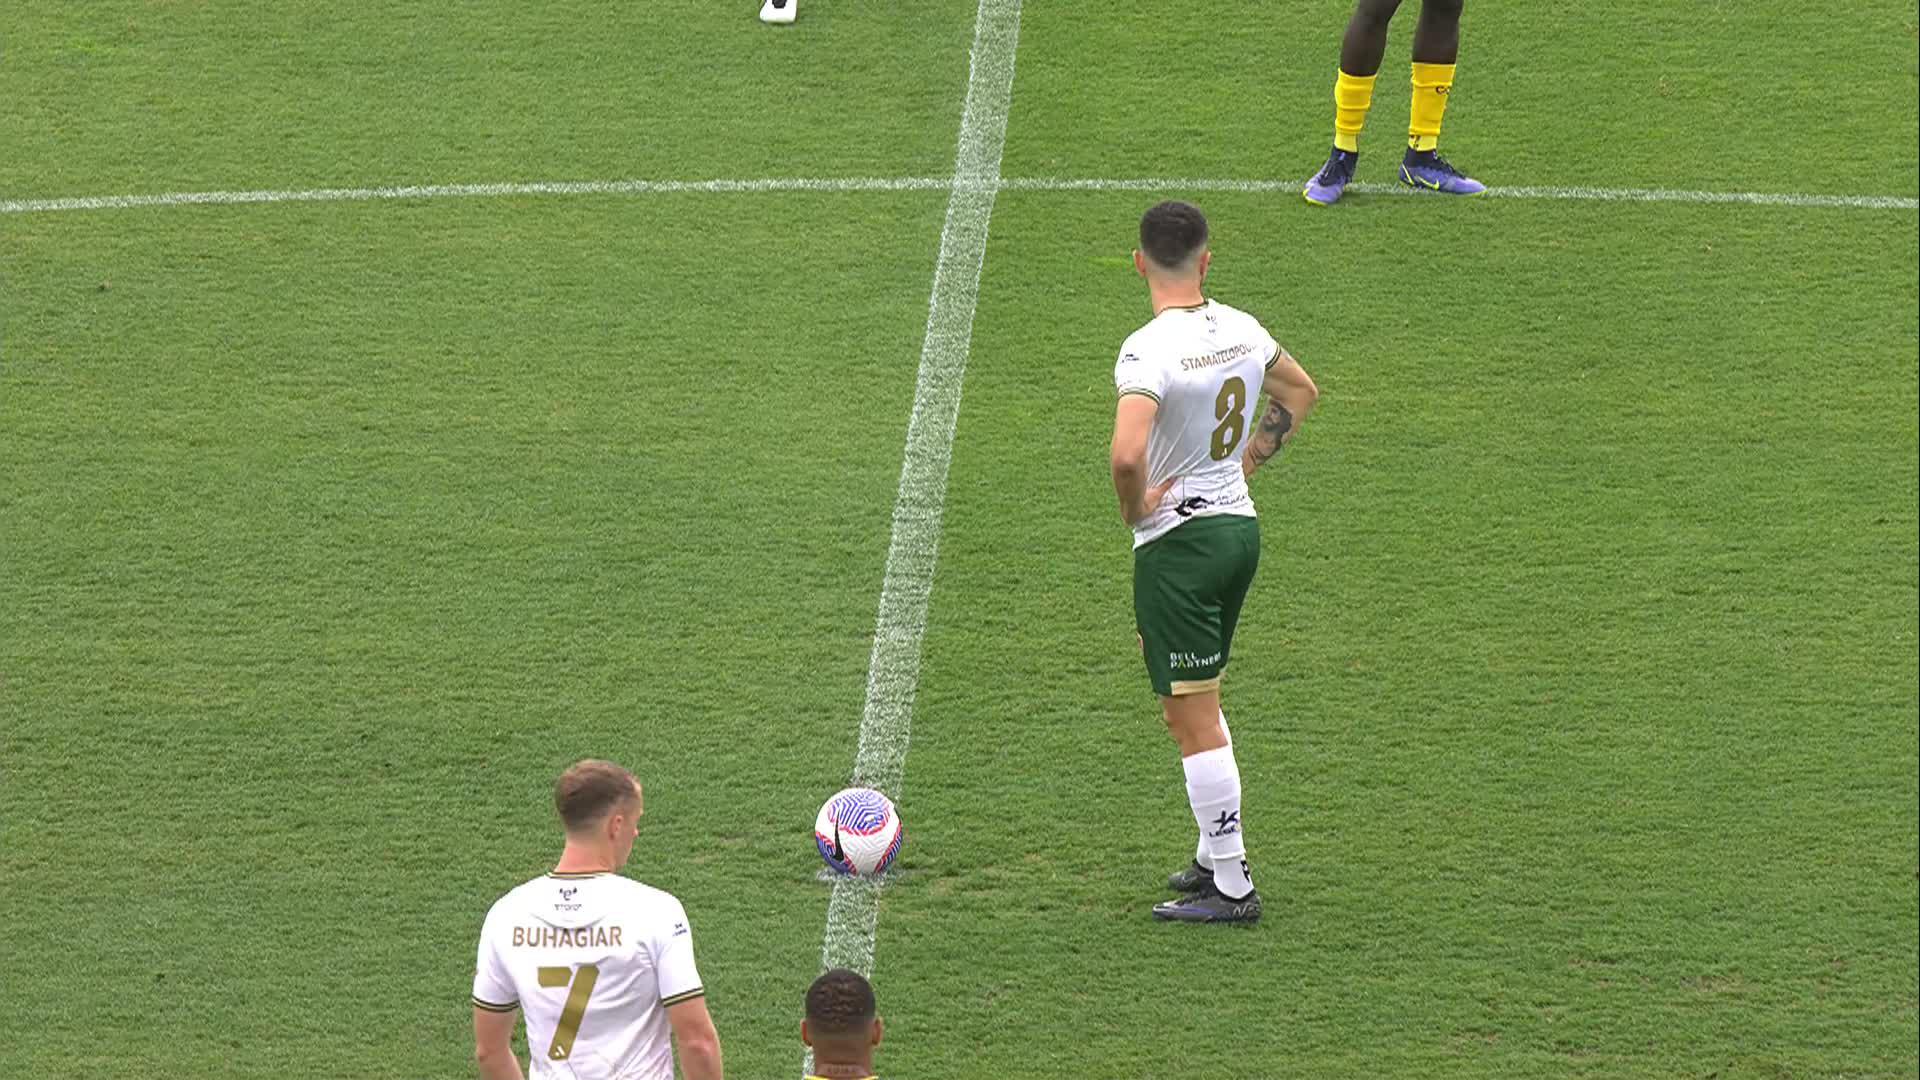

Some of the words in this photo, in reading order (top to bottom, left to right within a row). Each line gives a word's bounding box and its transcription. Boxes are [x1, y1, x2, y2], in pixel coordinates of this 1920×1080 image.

[1210, 376, 1246, 461] 8
[513, 926, 622, 948] BUHAGIAR
[537, 963, 600, 1060] 7
